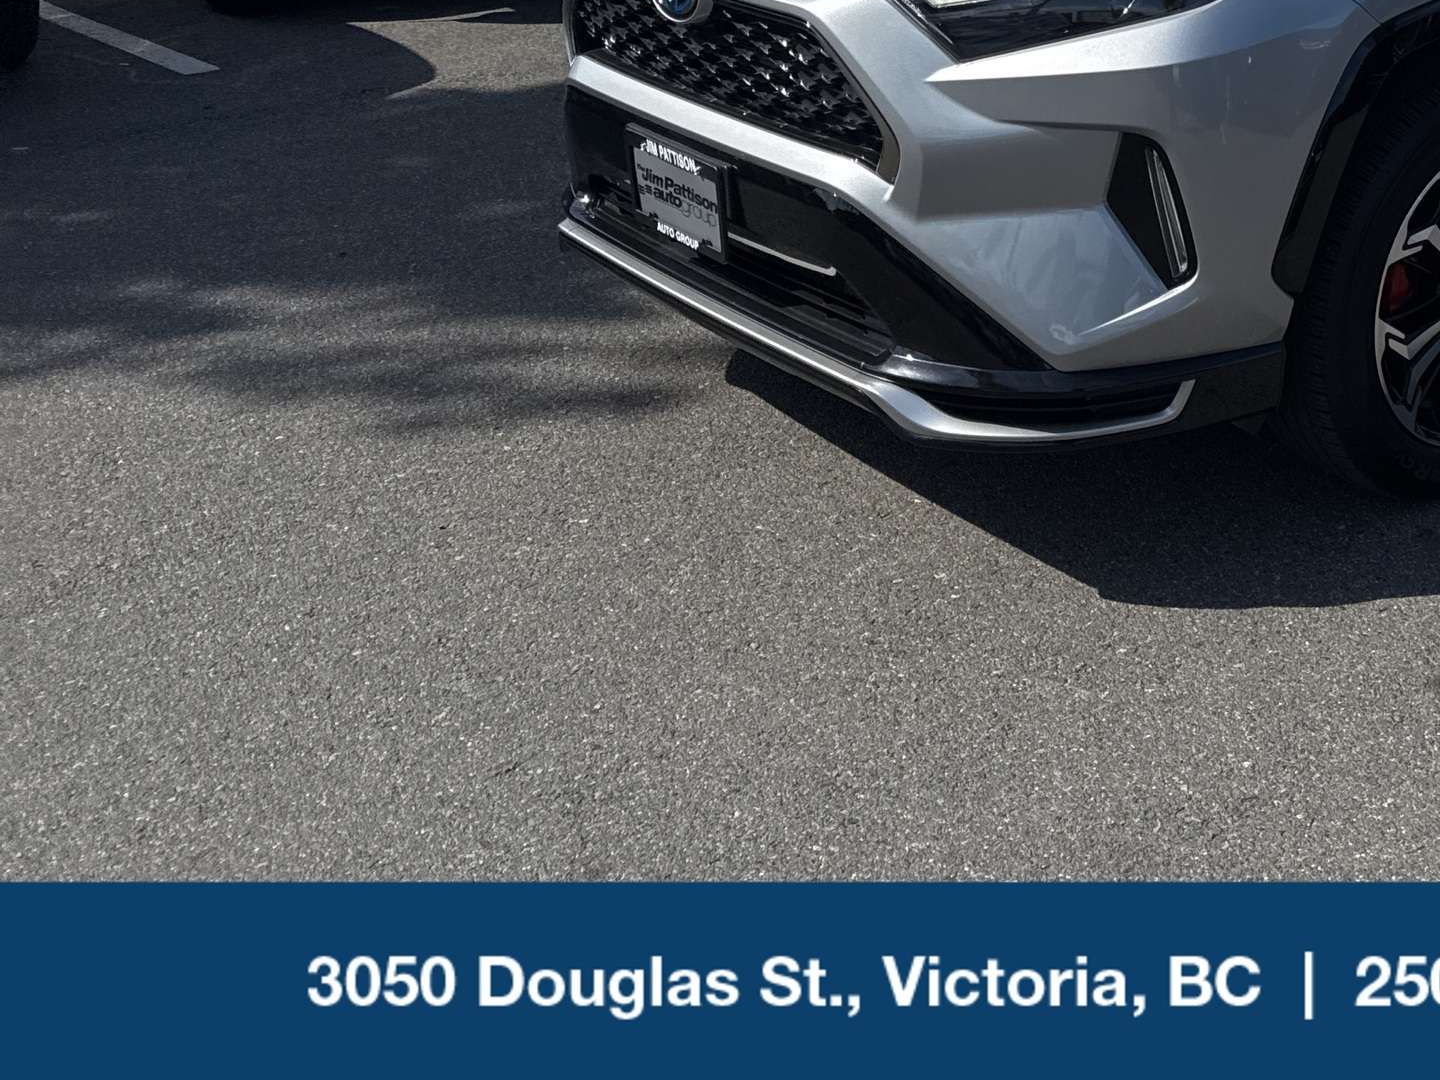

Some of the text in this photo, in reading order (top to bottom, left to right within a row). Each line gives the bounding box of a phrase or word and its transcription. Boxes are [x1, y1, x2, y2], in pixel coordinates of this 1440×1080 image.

[646, 139, 697, 173] JIM PATTISON
[641, 167, 718, 213] Jim Pattison
[653, 186, 682, 208] auto
[656, 221, 700, 251] AUTO GROUP
